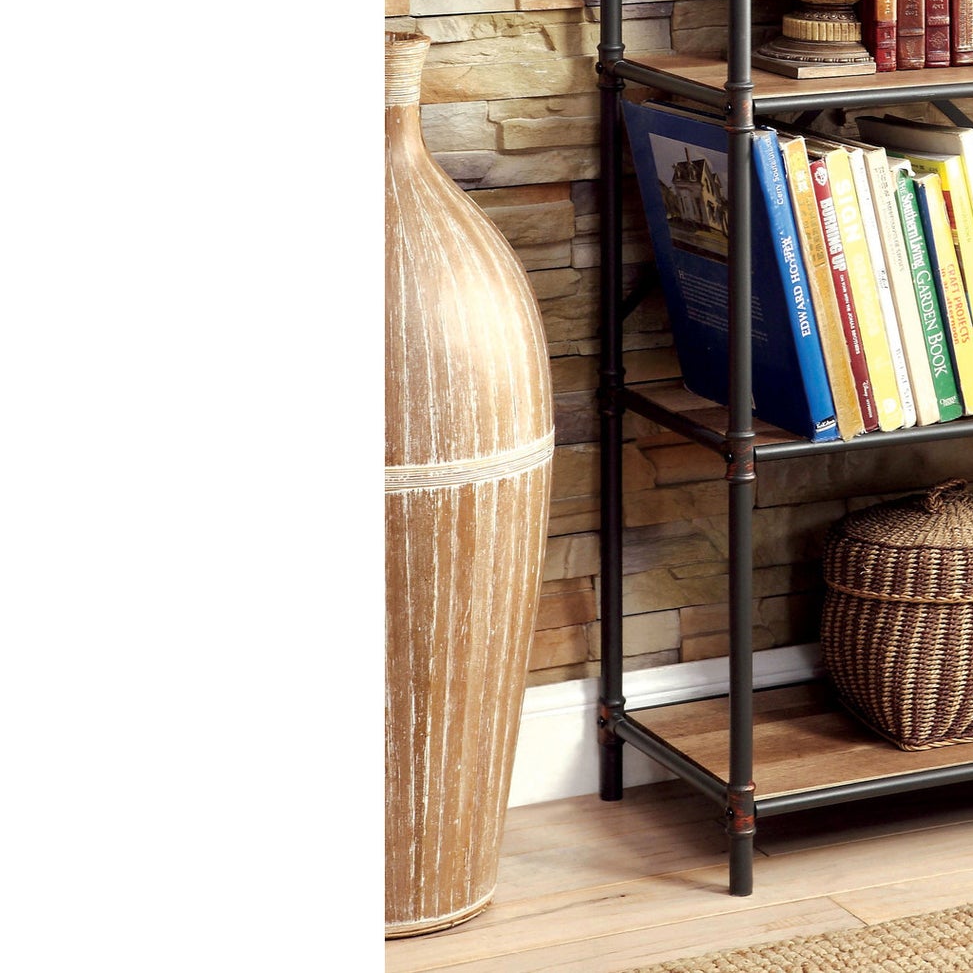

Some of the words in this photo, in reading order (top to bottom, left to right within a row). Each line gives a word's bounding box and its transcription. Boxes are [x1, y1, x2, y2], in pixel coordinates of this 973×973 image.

[820, 196, 842, 254] BURNING
[835, 178, 860, 243] SIGN
[830, 254, 847, 272] UP
[793, 284, 812, 337] EDWARD
[916, 270, 941, 332] GARDEN
[946, 263, 959, 293] CRAFT
[953, 297, 969, 343] PROJECTS
[927, 332, 948, 377] BOOK
